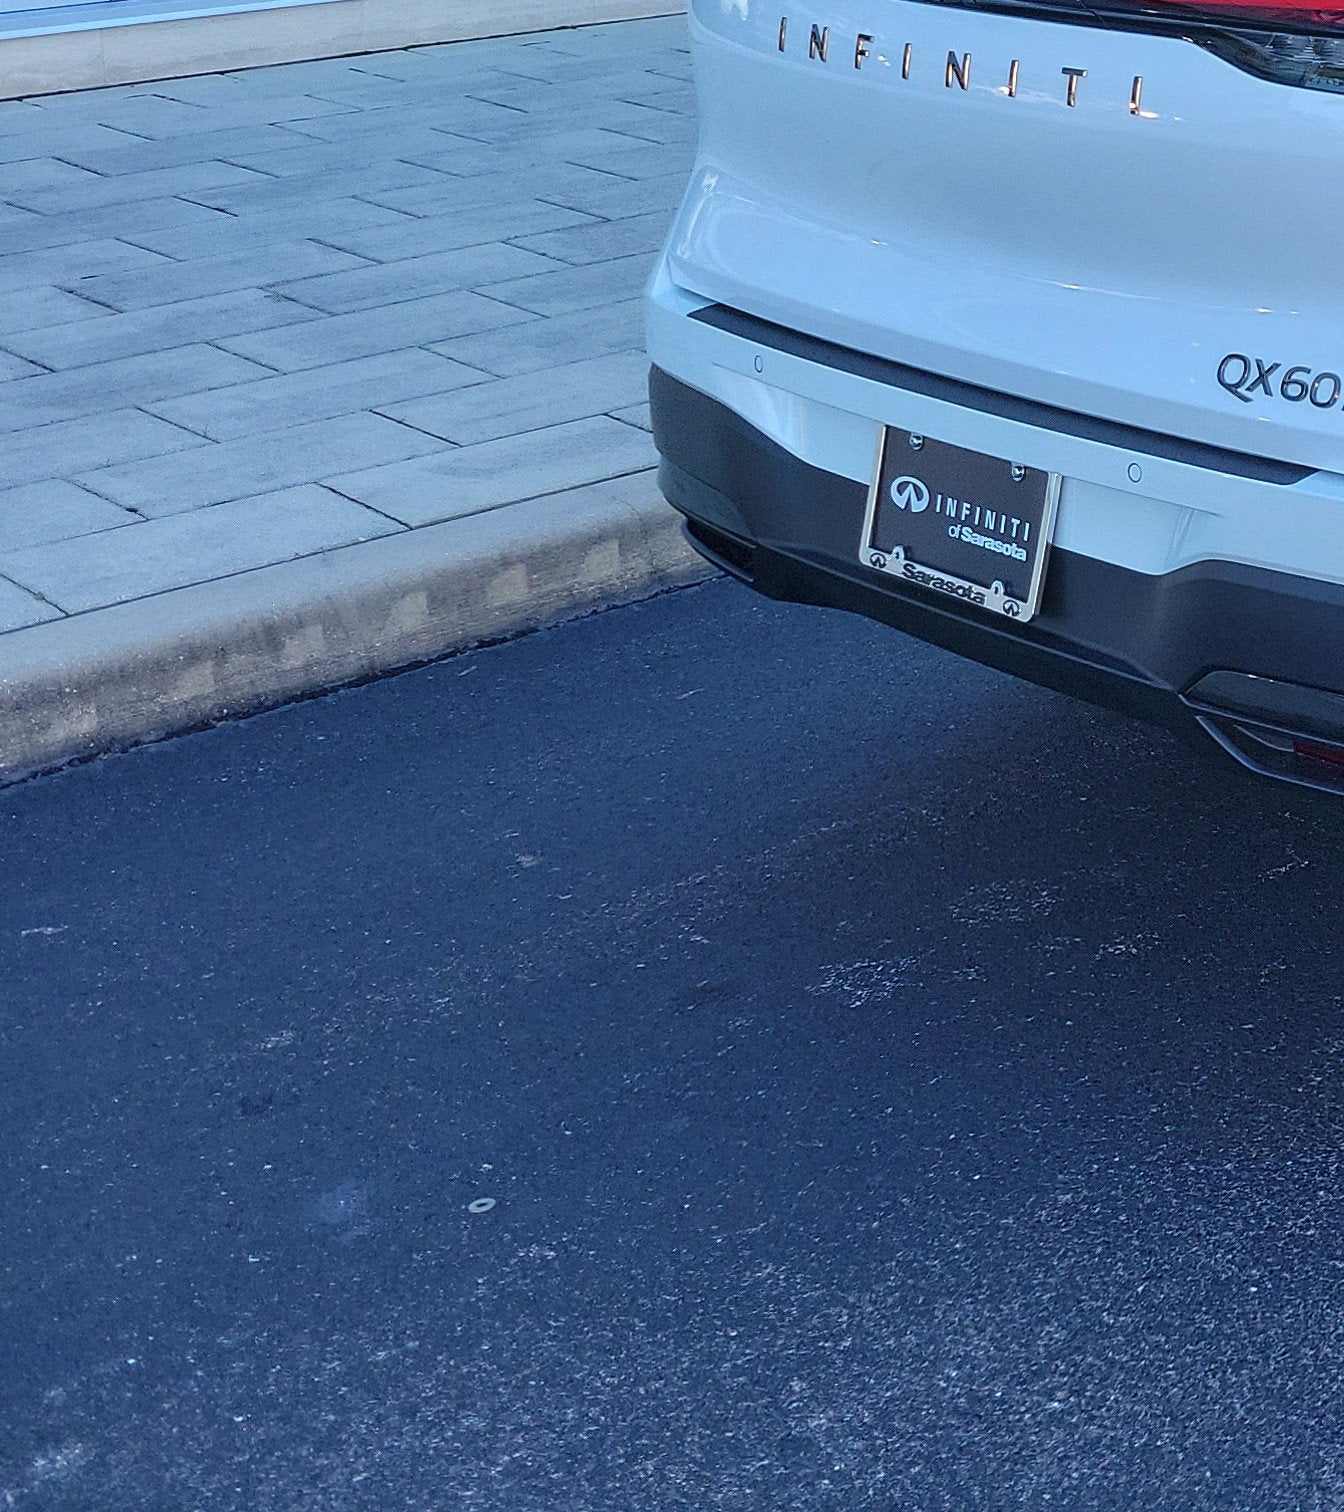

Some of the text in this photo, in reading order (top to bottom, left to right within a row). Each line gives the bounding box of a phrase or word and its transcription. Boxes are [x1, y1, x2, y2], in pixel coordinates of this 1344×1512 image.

[778, 16, 1142, 115] INFINITI
[935, 494, 1031, 541] INFINITI
[948, 525, 1027, 561] of Sarasota
[902, 563, 986, 604] Sarasota
